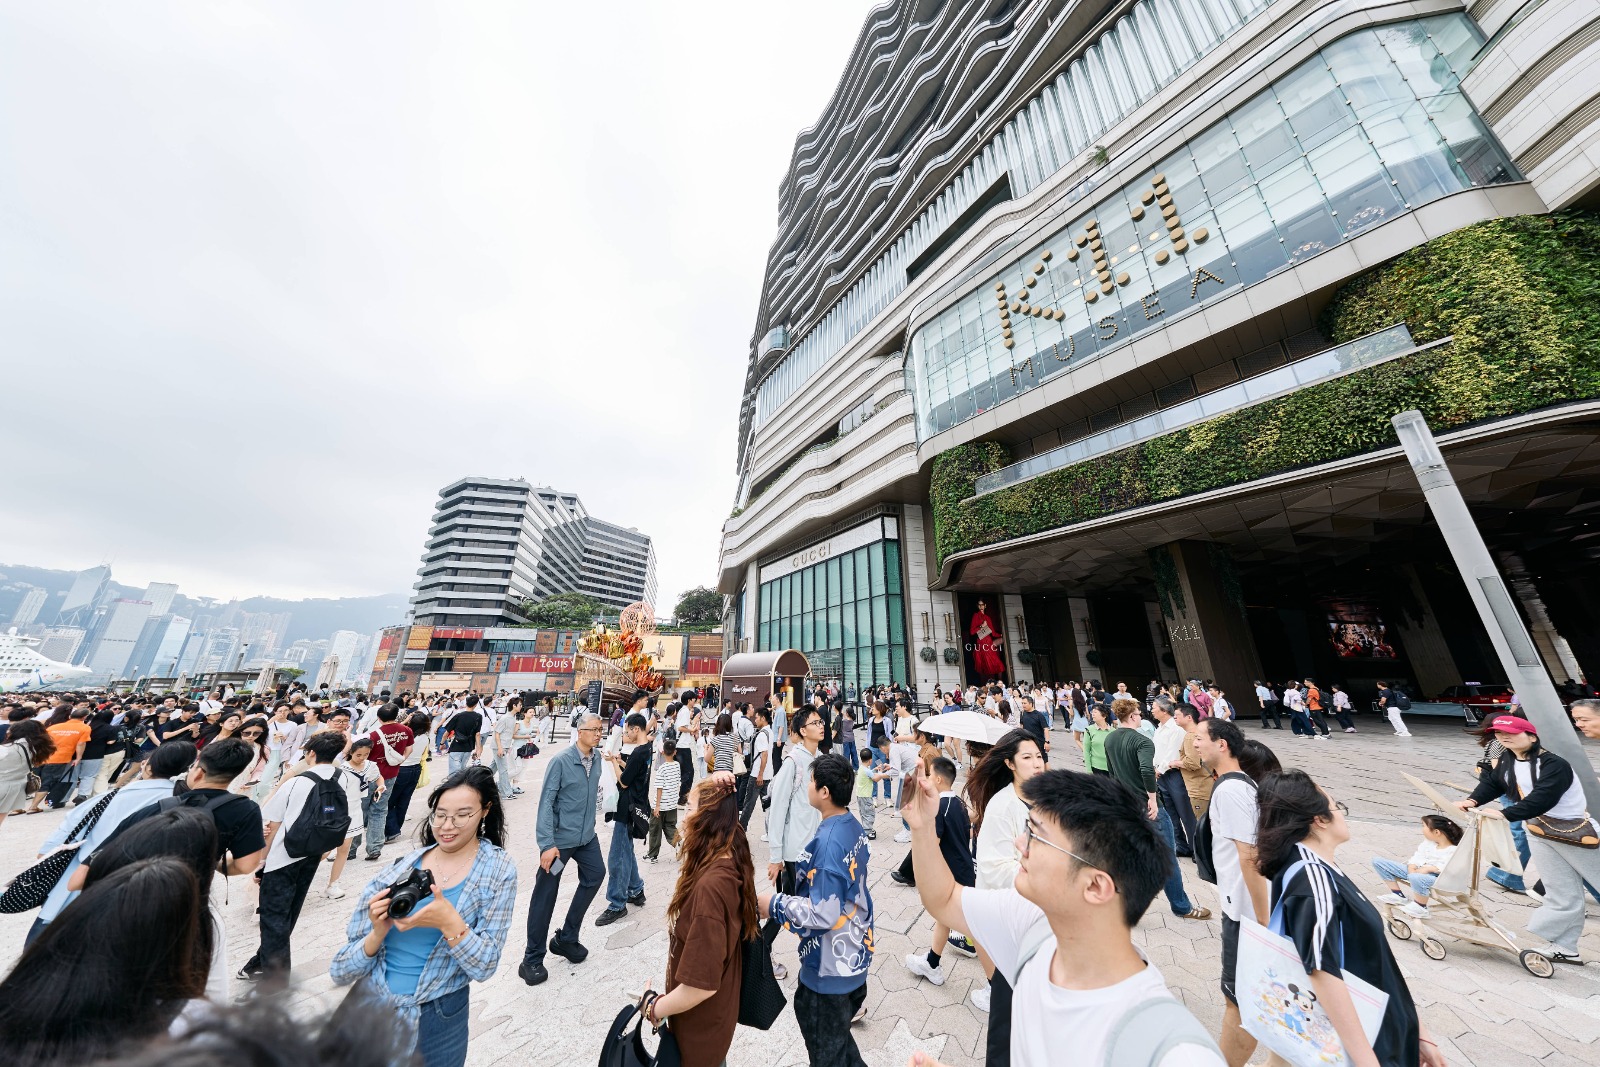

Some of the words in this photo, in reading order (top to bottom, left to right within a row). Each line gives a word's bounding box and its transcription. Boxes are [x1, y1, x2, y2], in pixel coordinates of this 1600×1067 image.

[995, 173, 1209, 350] K11
[1009, 267, 1224, 386] MUSEA
[793, 543, 831, 568] GUCCI
[1169, 623, 1201, 642] K11
[965, 643, 1002, 651] GUCCI
[541, 660, 568, 668] LOUIS
